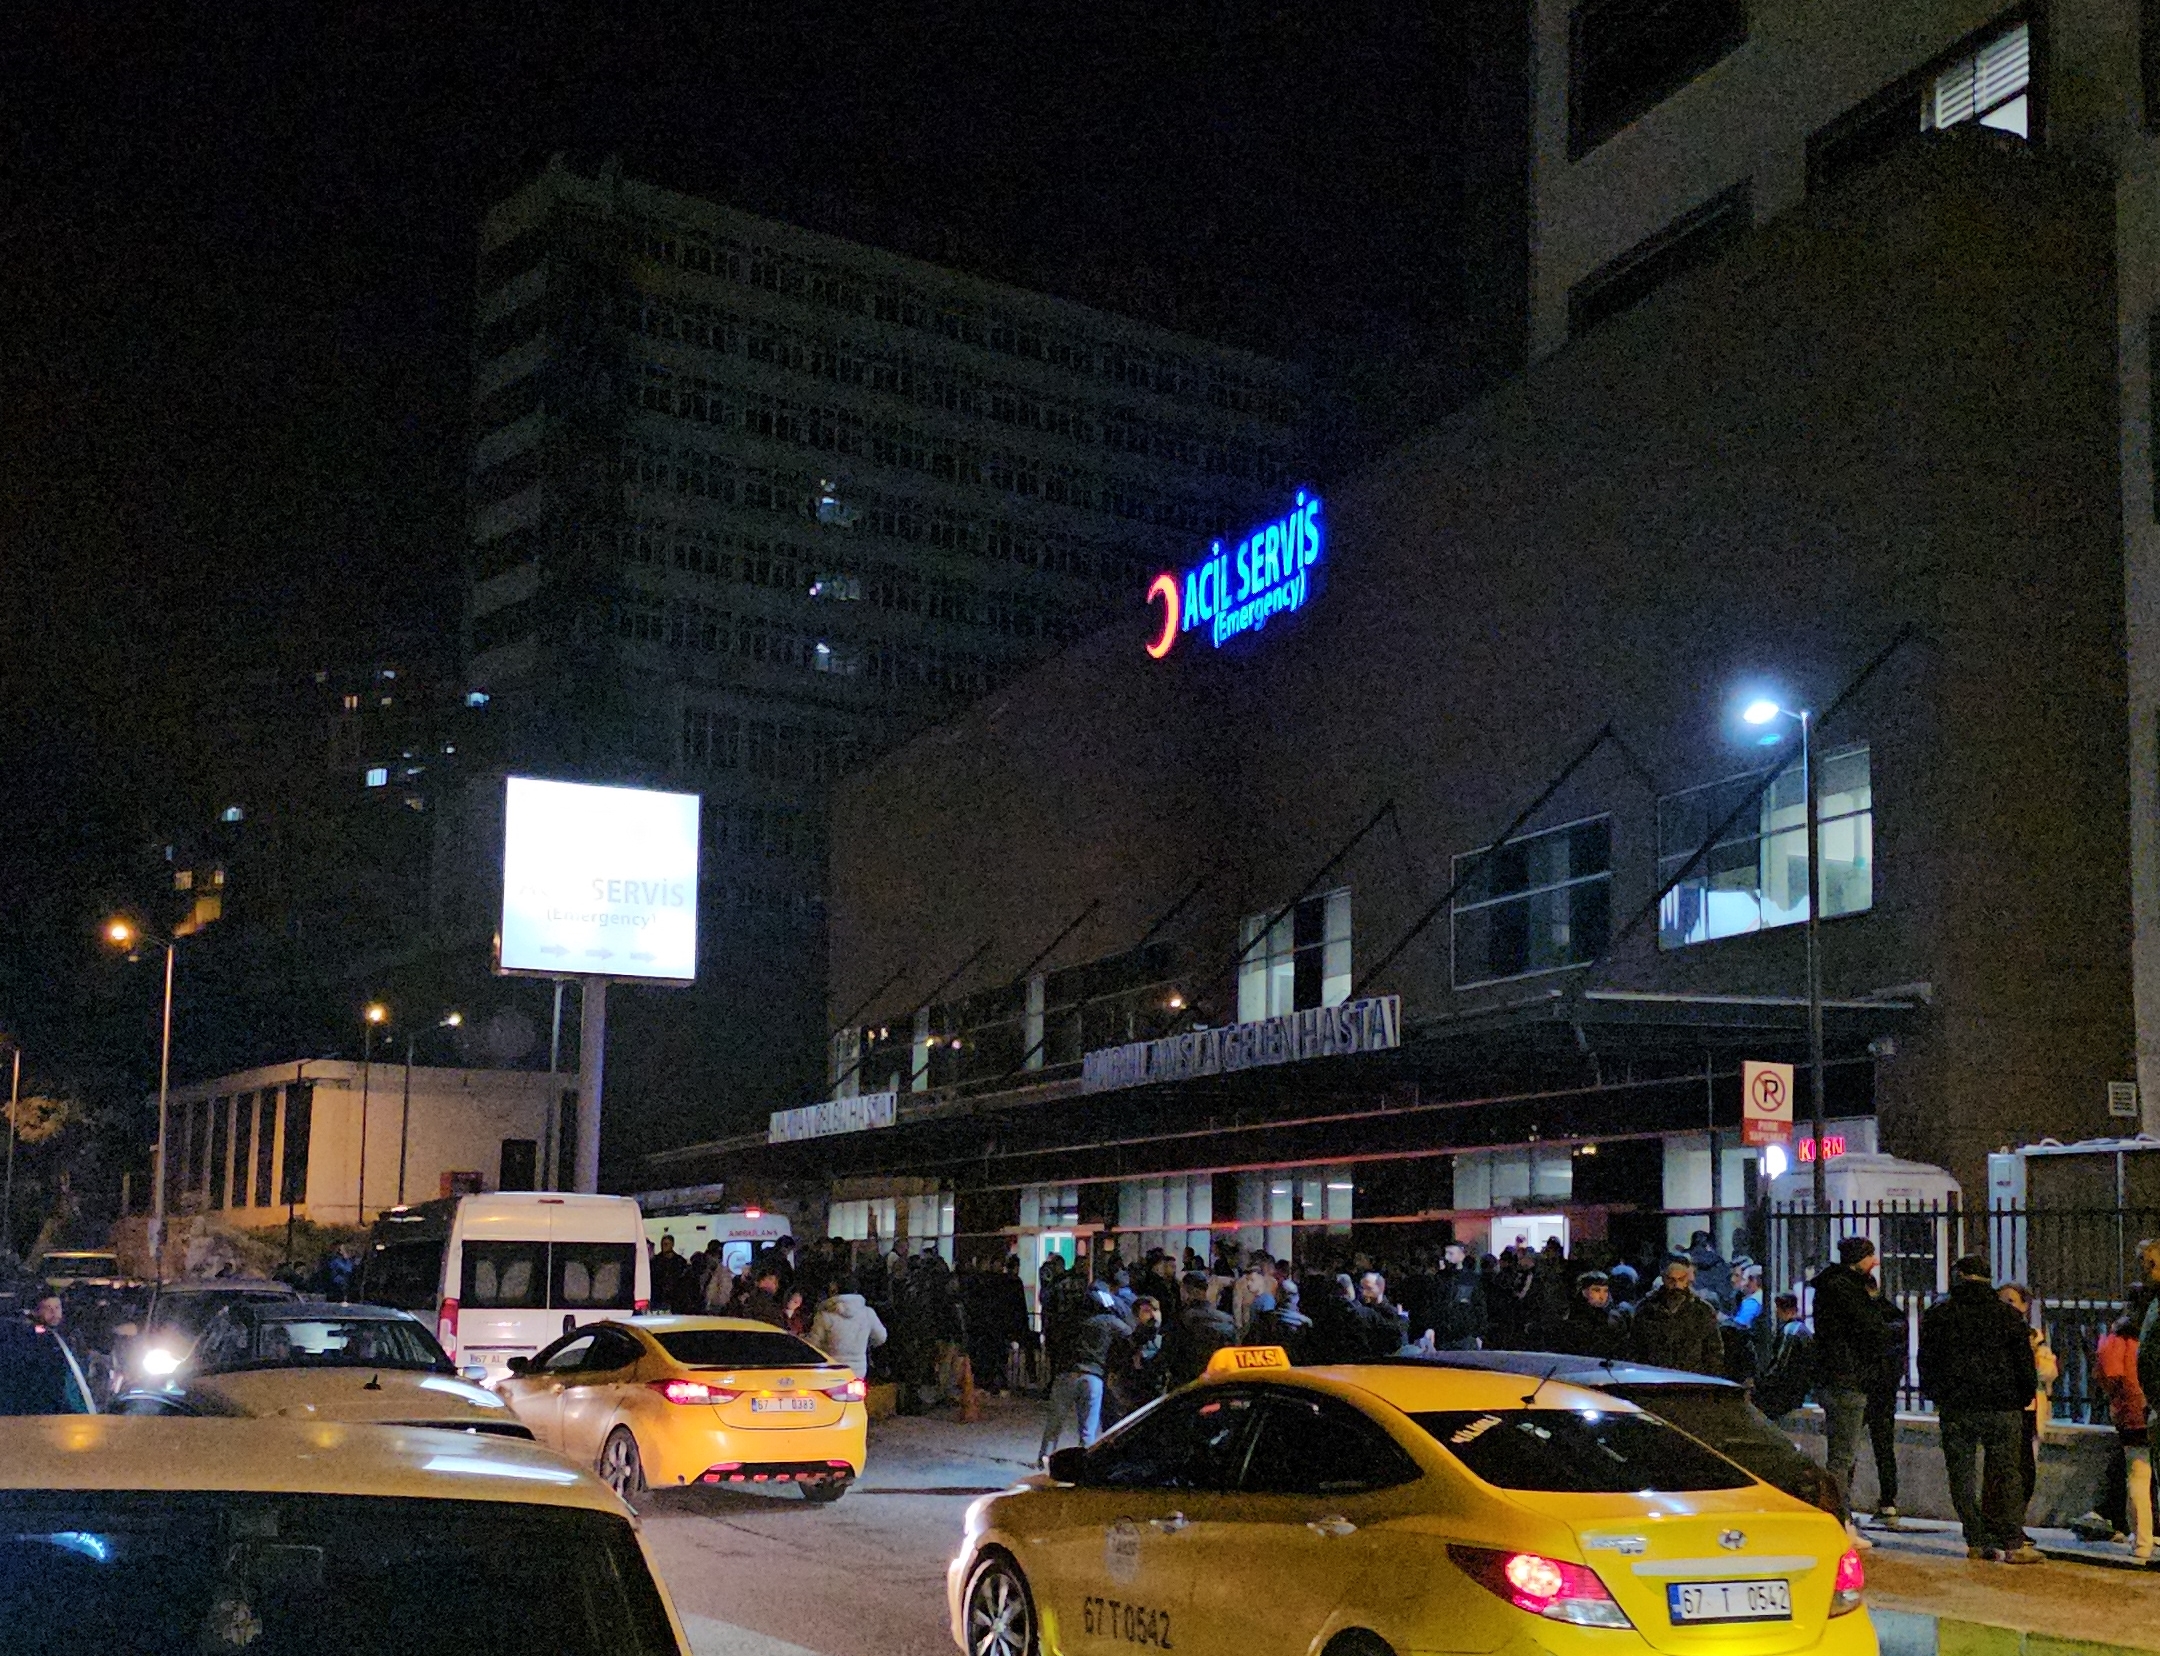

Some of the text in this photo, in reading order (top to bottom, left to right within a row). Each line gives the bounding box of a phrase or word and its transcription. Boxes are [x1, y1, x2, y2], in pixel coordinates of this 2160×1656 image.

[1182, 491, 1319, 632] ACİL SERVİS
[1213, 567, 1305, 648] (Emergency)
[591, 878, 685, 908] SERVİS
[1298, 1000, 1397, 1058] HASTA
[757, 1399, 769, 1411] 67
[778, 1398, 783, 1410] T
[1683, 1585, 1789, 1614] 67 T 0542
